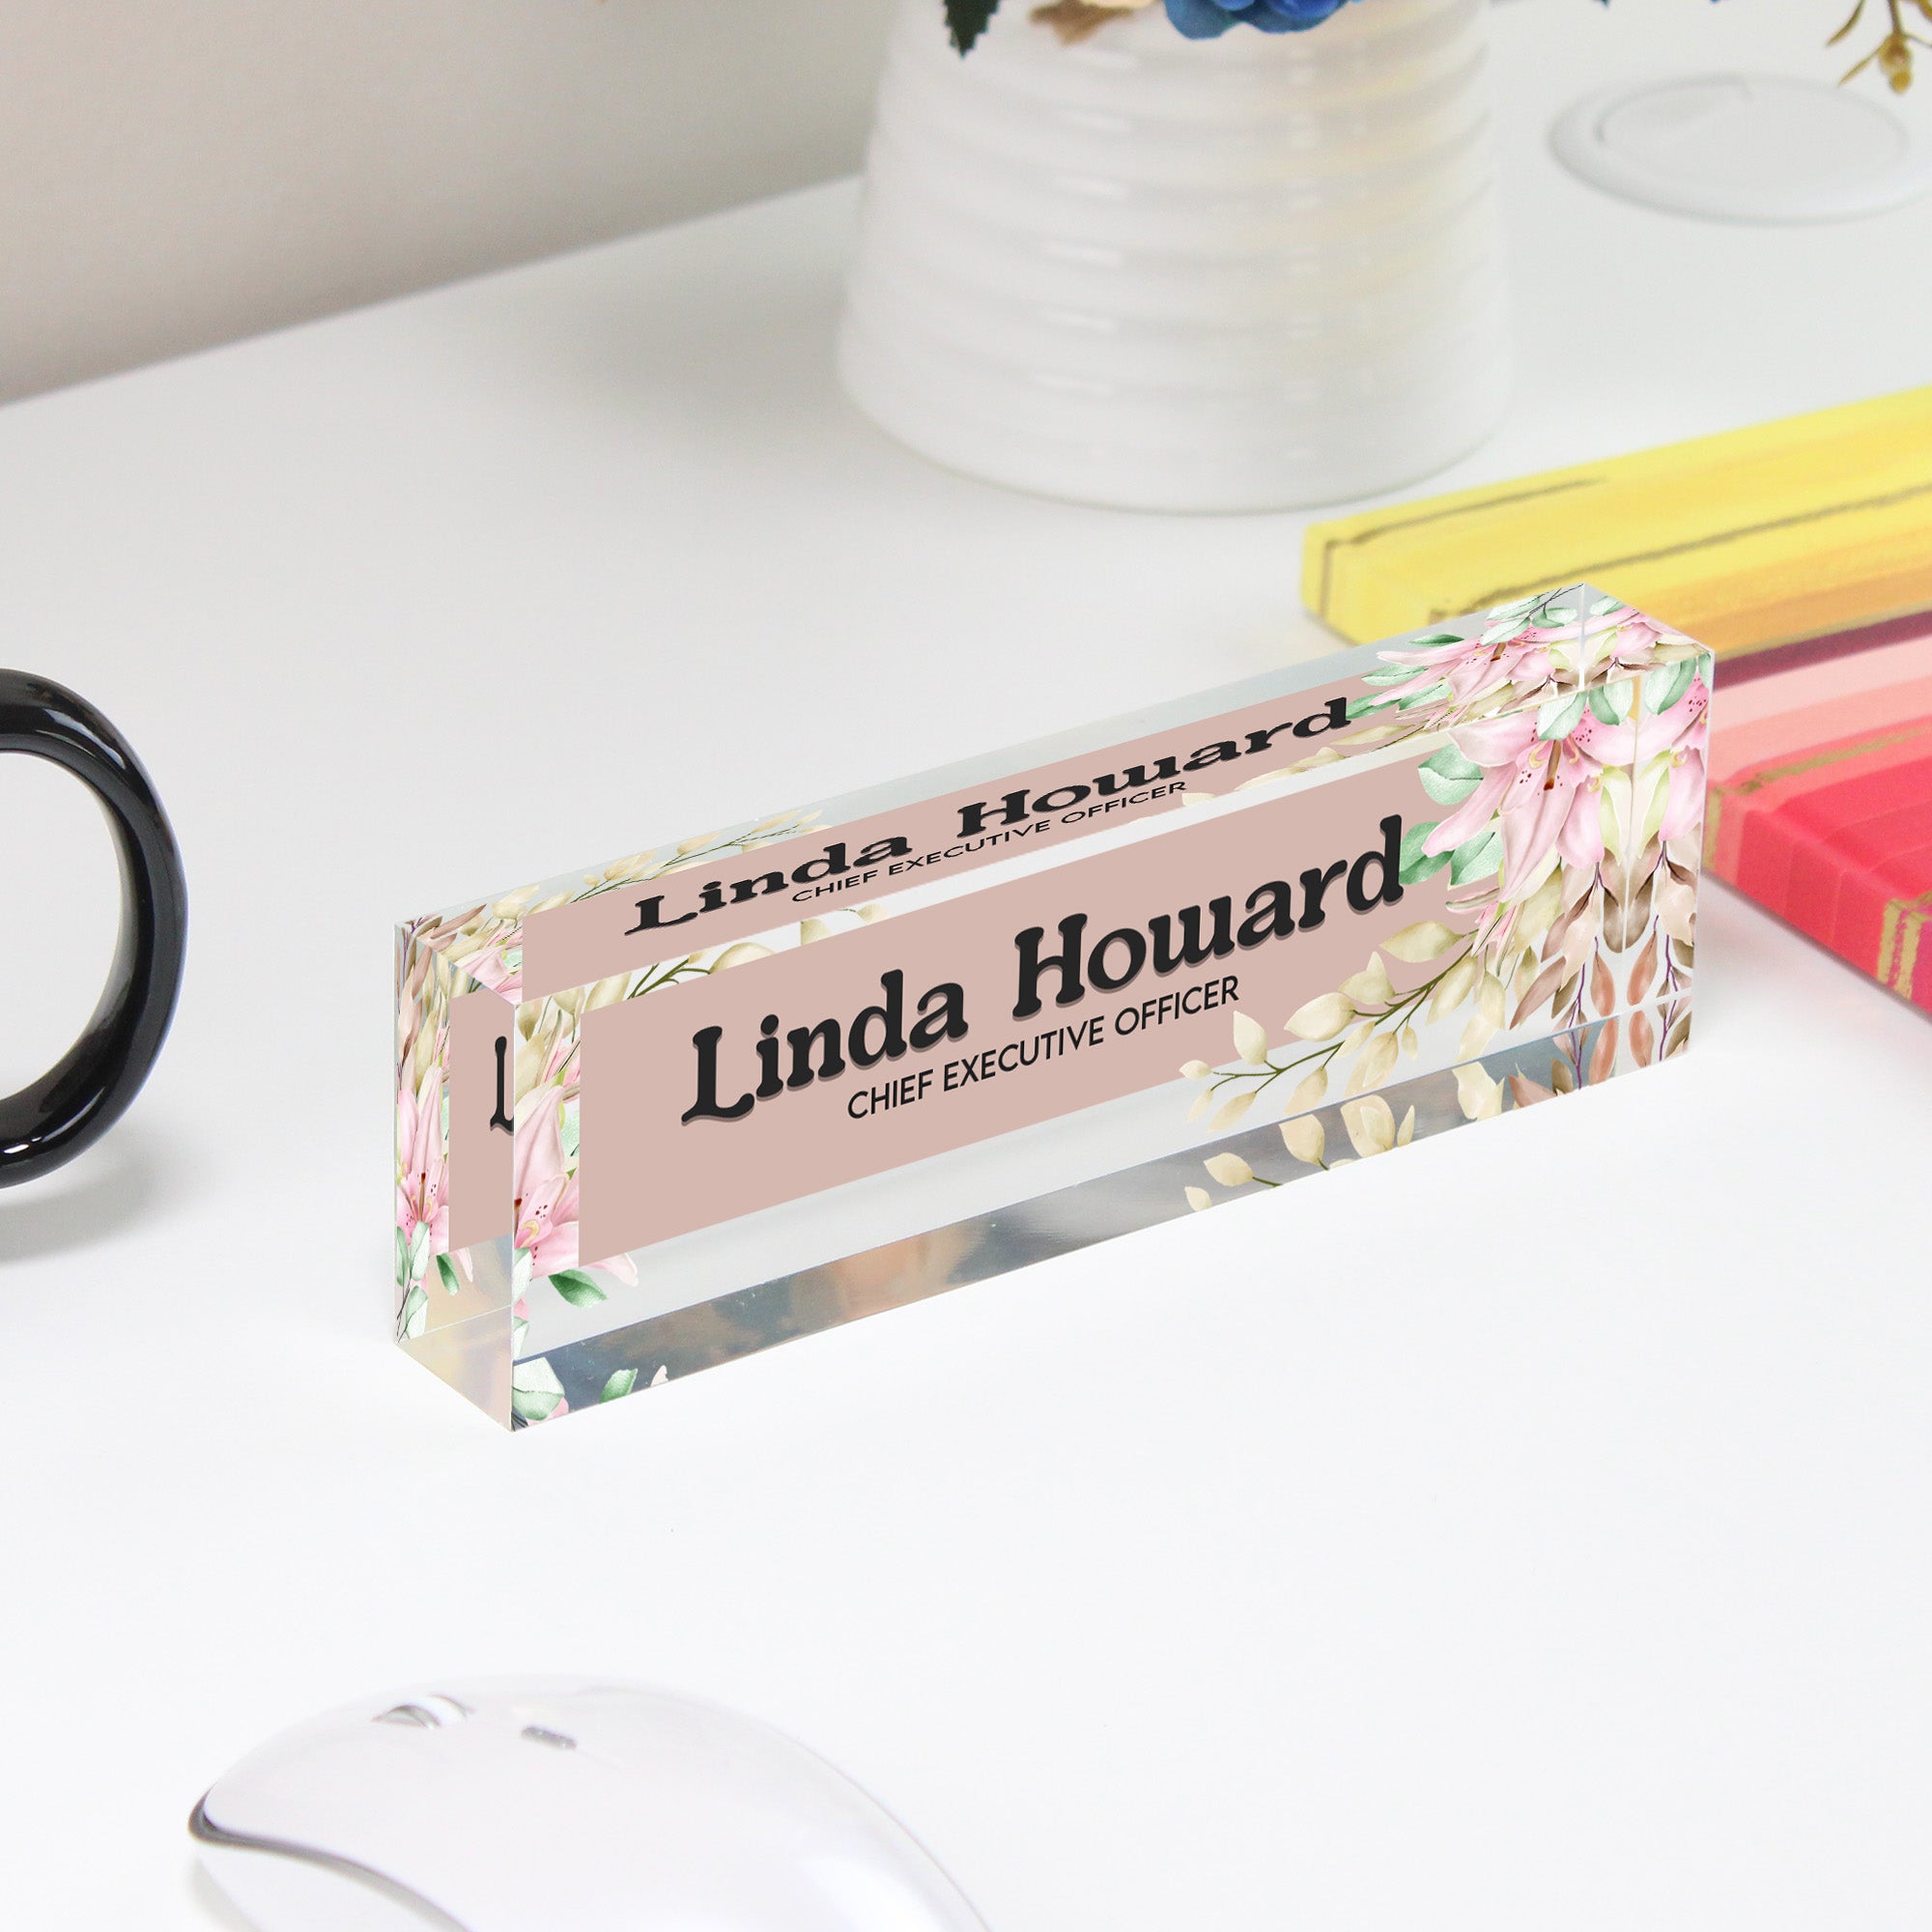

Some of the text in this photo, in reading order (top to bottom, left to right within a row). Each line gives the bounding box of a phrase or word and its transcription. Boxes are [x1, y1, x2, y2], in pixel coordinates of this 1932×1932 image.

[624, 696, 1351, 936] Linda Howard
[791, 781, 1187, 903] CHIEF EXECUTIVE OFFICER
[681, 969, 969, 1124] Linda
[1011, 814, 1406, 1021] Howard
[847, 975, 1239, 1120] CHIEF EXECUTIVE OFFICER
